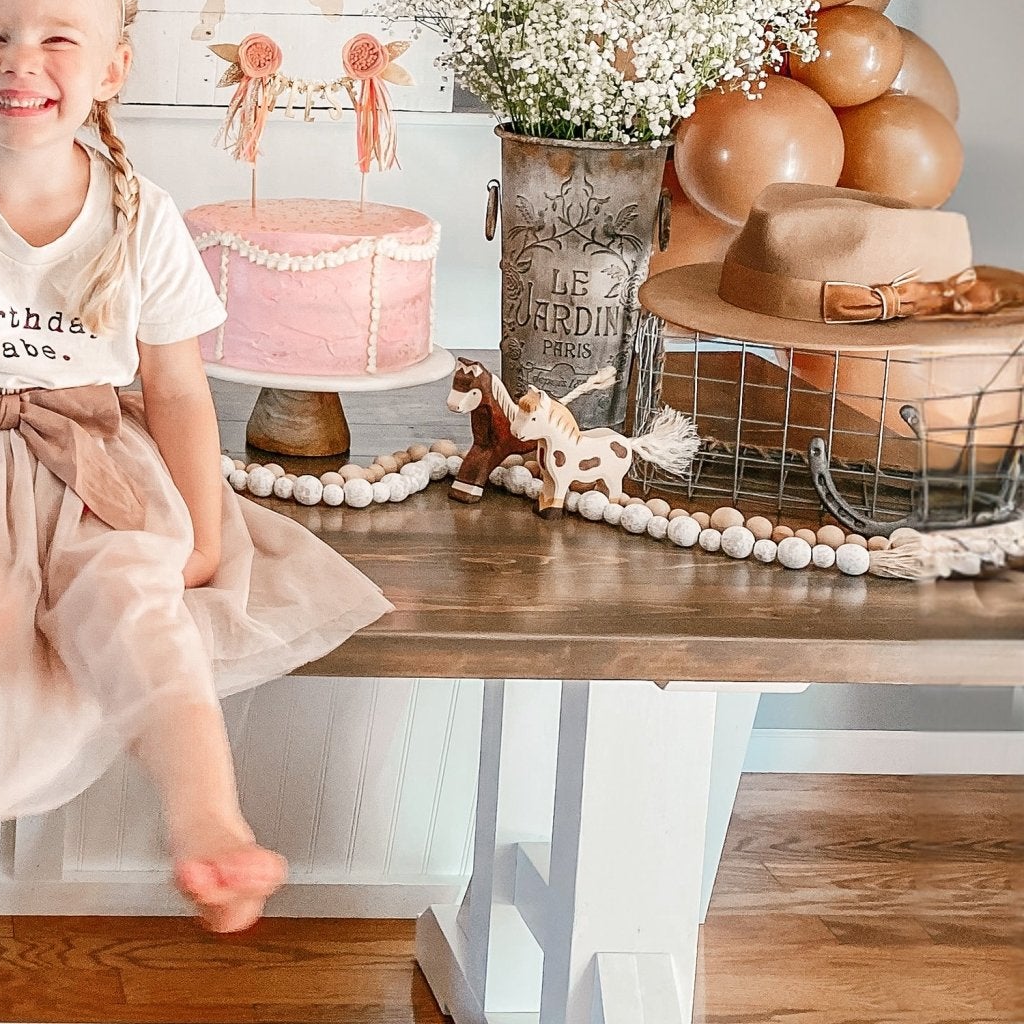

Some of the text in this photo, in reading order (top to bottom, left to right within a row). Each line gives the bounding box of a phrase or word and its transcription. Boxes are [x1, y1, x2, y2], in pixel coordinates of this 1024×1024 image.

[551, 269, 589, 296] LE
[516, 282, 620, 336] JARDIN
[543, 339, 592, 359] PARIS
